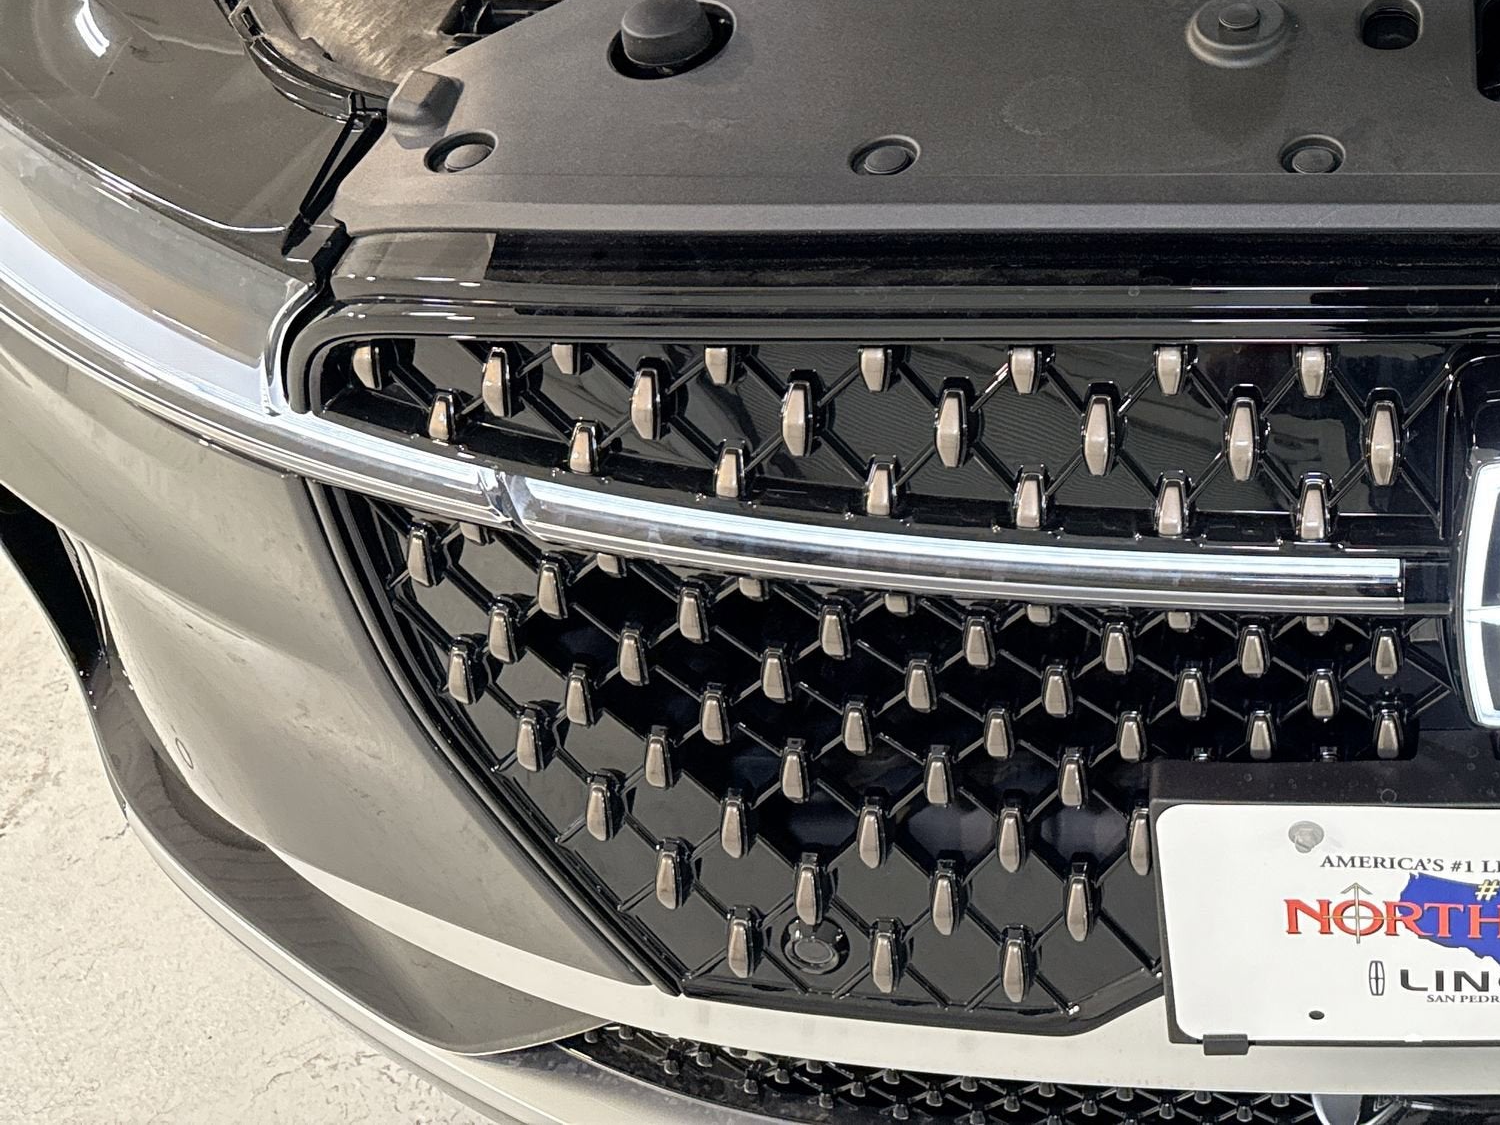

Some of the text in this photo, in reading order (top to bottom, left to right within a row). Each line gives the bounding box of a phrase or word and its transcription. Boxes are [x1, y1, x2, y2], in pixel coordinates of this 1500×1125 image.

[1320, 854, 1444, 872] AMERICA'S
[1450, 860, 1474, 873] #1
[1427, 993, 1457, 1004] SAN
